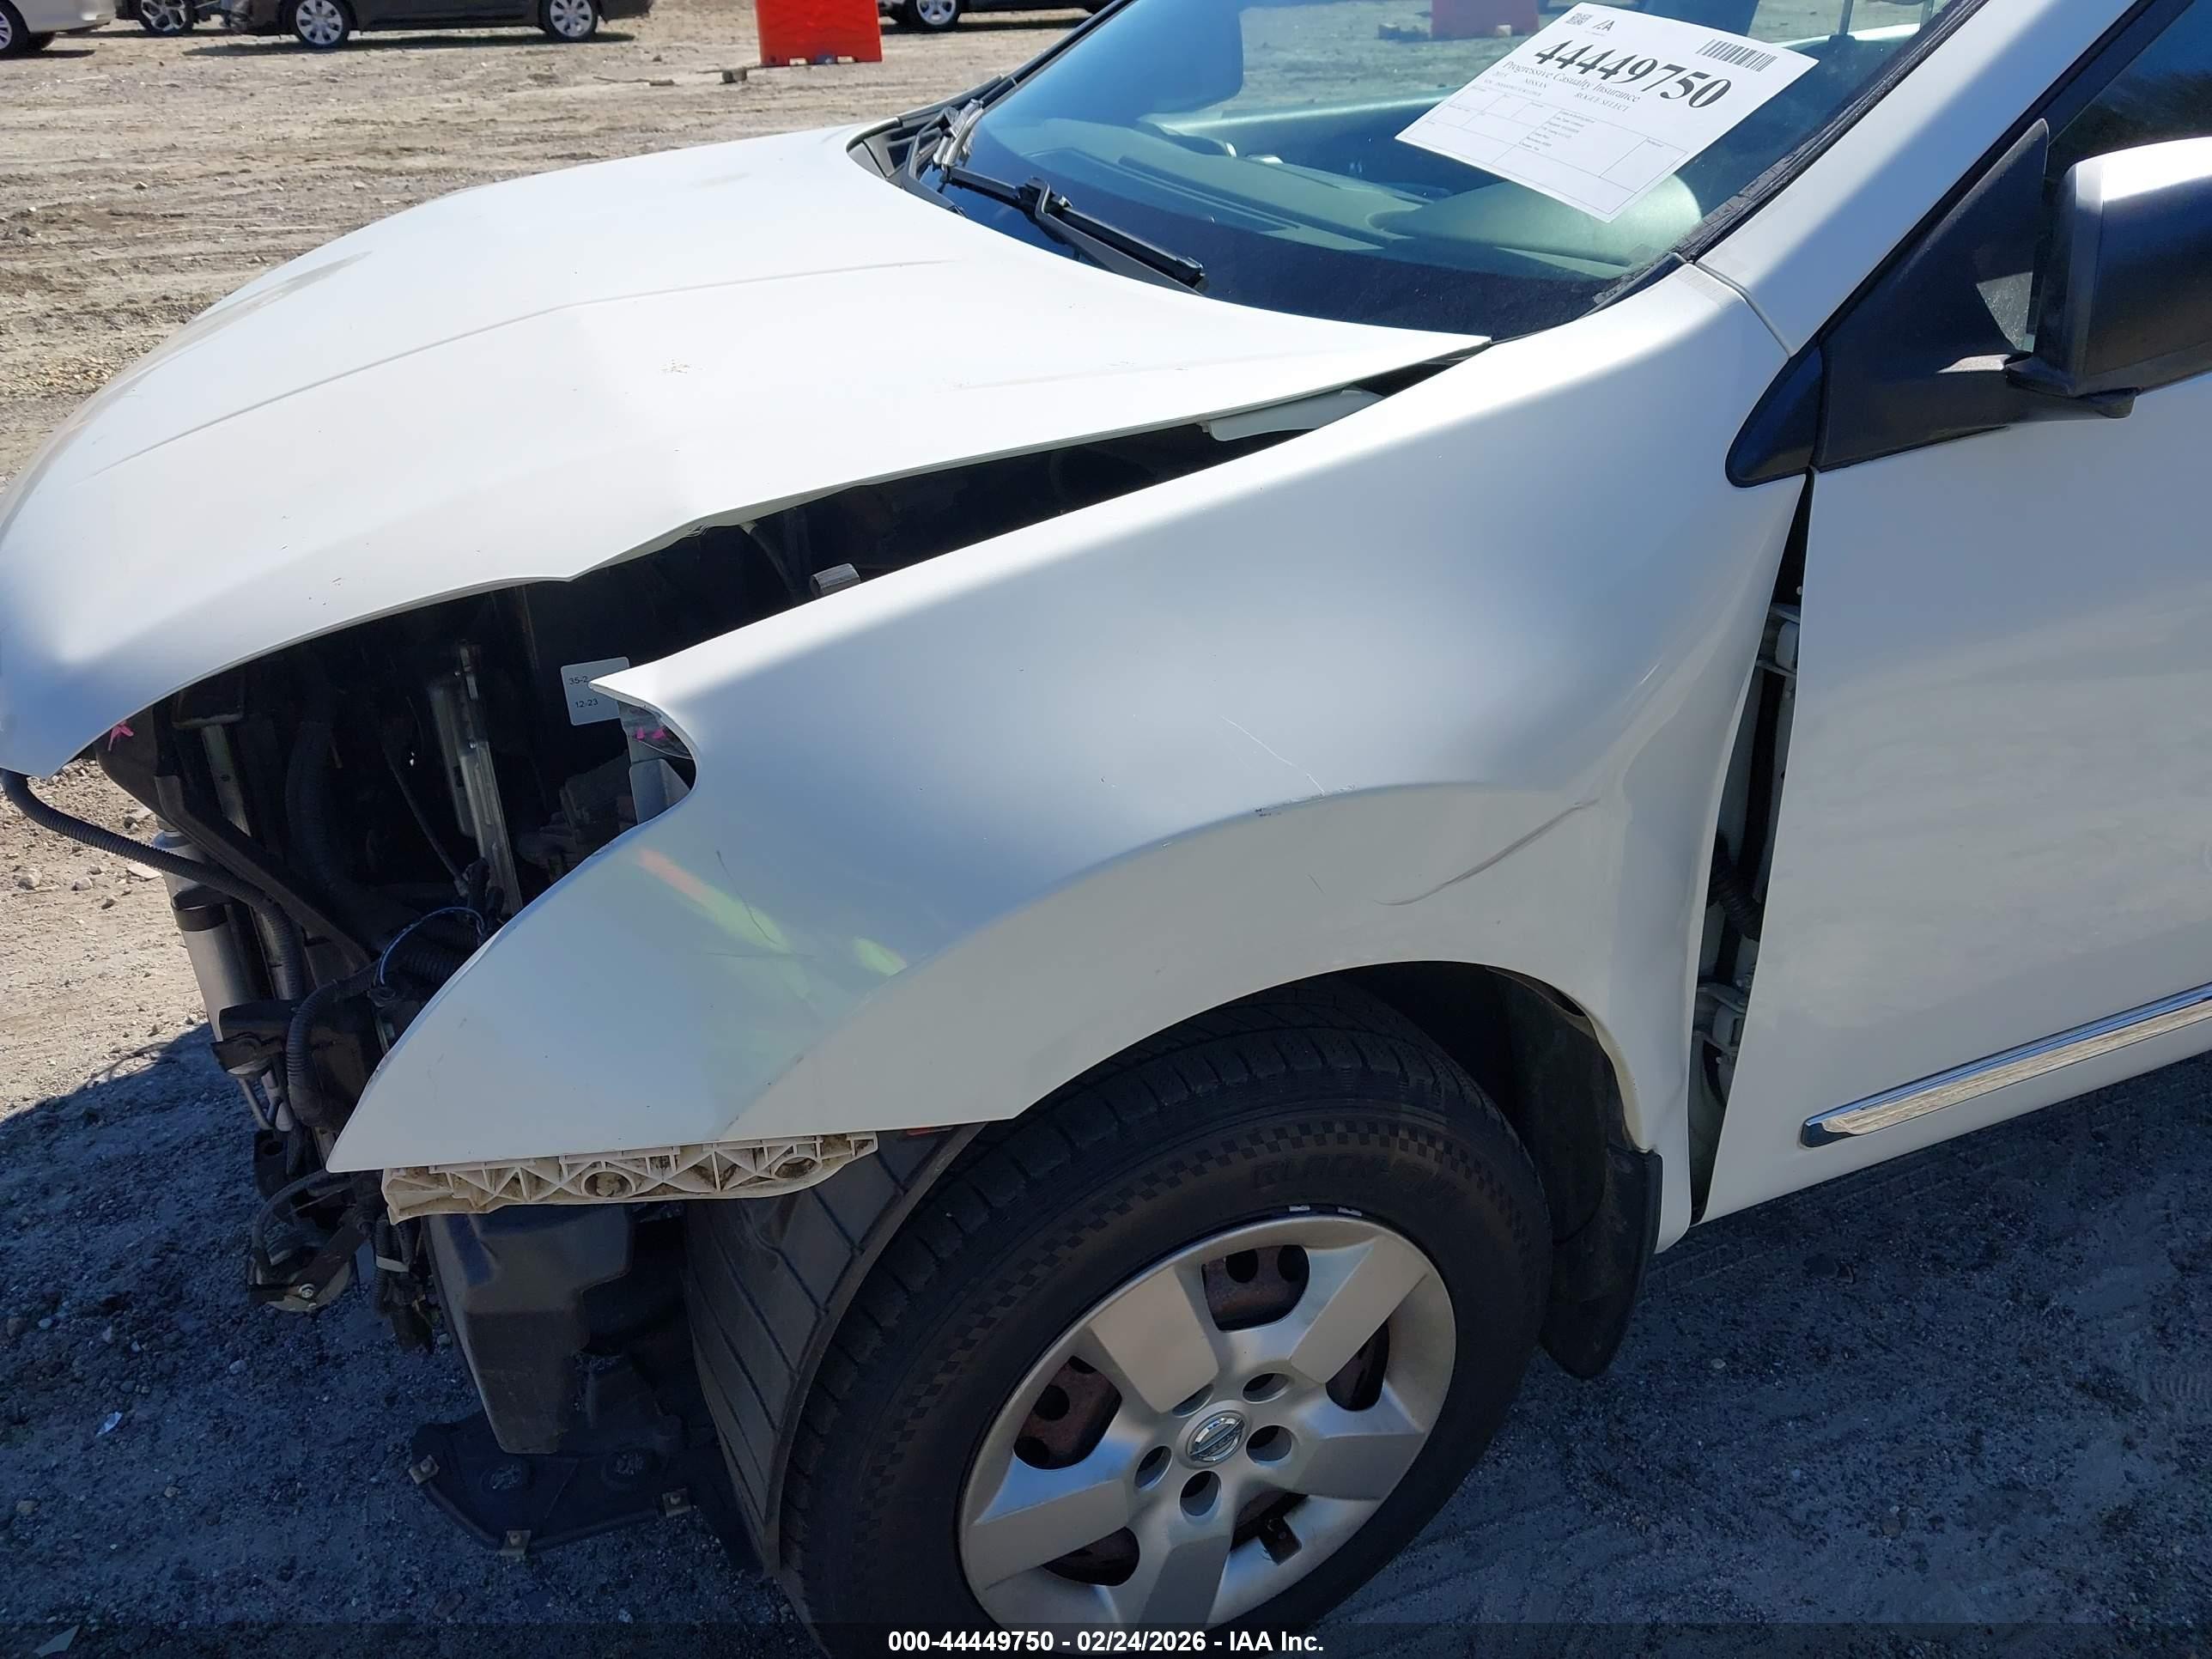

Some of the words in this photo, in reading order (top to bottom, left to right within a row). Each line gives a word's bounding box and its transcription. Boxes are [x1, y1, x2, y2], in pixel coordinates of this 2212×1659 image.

[1503, 60, 1553, 78] Progressive
[1553, 73, 1590, 90] Casualty
[1593, 82, 1641, 102] Insurance
[1534, 40, 1732, 109] 44449750
